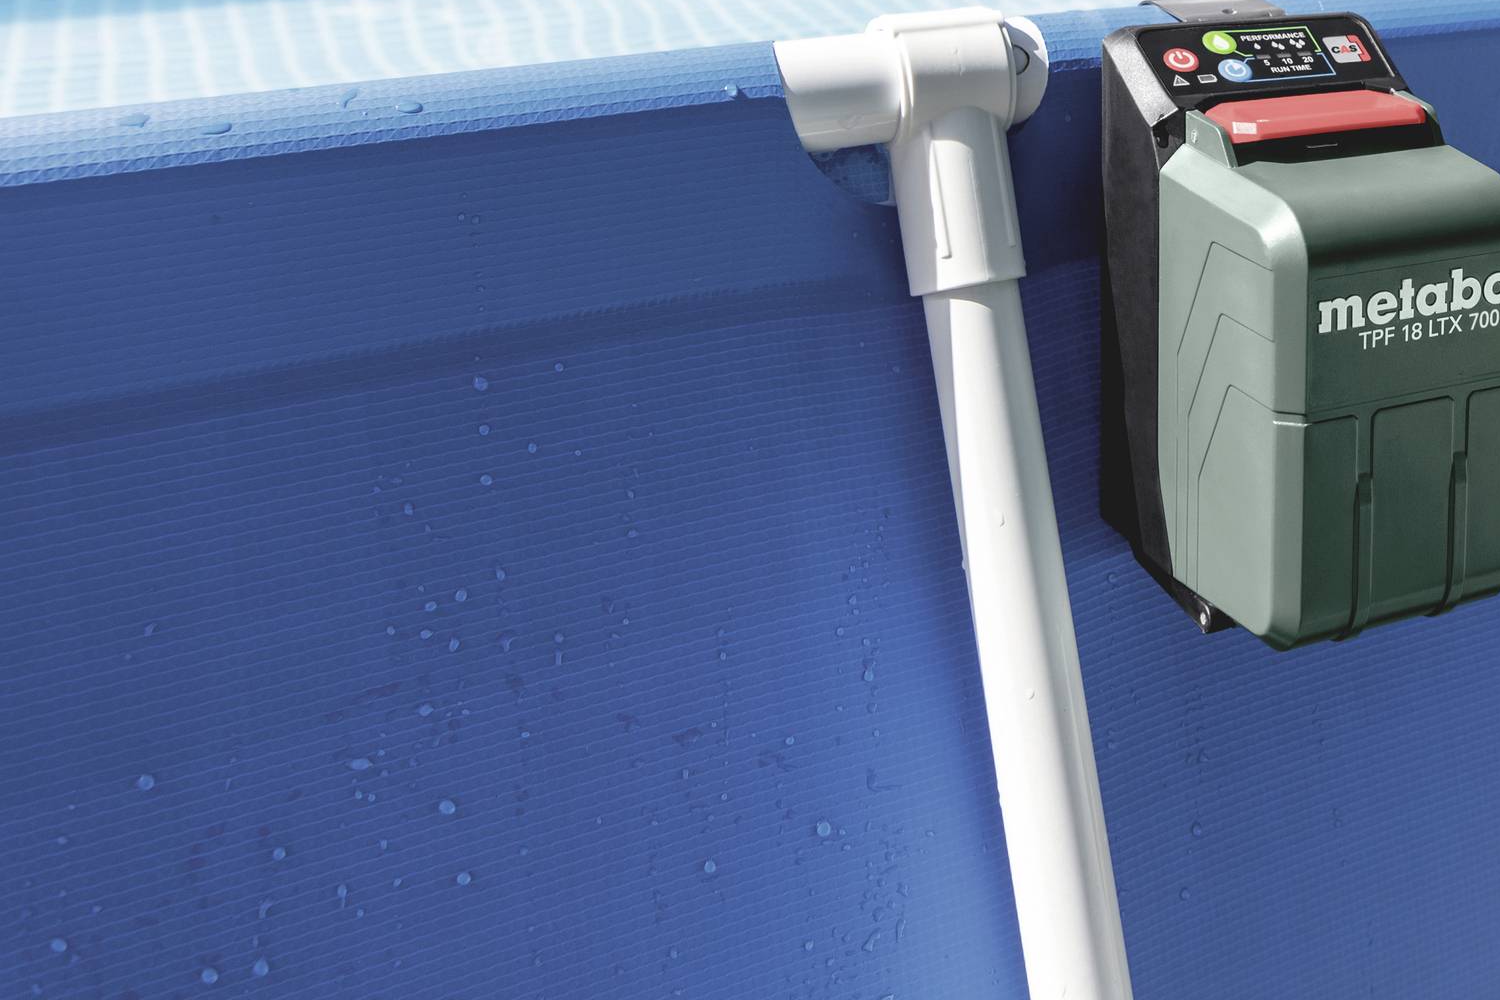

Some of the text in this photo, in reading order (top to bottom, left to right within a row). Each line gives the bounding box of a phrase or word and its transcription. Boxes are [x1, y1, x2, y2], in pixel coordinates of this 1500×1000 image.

[1240, 32, 1306, 42] PERFORMANCE
[1332, 45, 1358, 54] CAS
[1281, 57, 1294, 65] 10
[1270, 66, 1291, 74] RUN
[1358, 326, 1396, 350] TPF
[1402, 322, 1422, 342] 18
[1428, 314, 1463, 338] LTX
